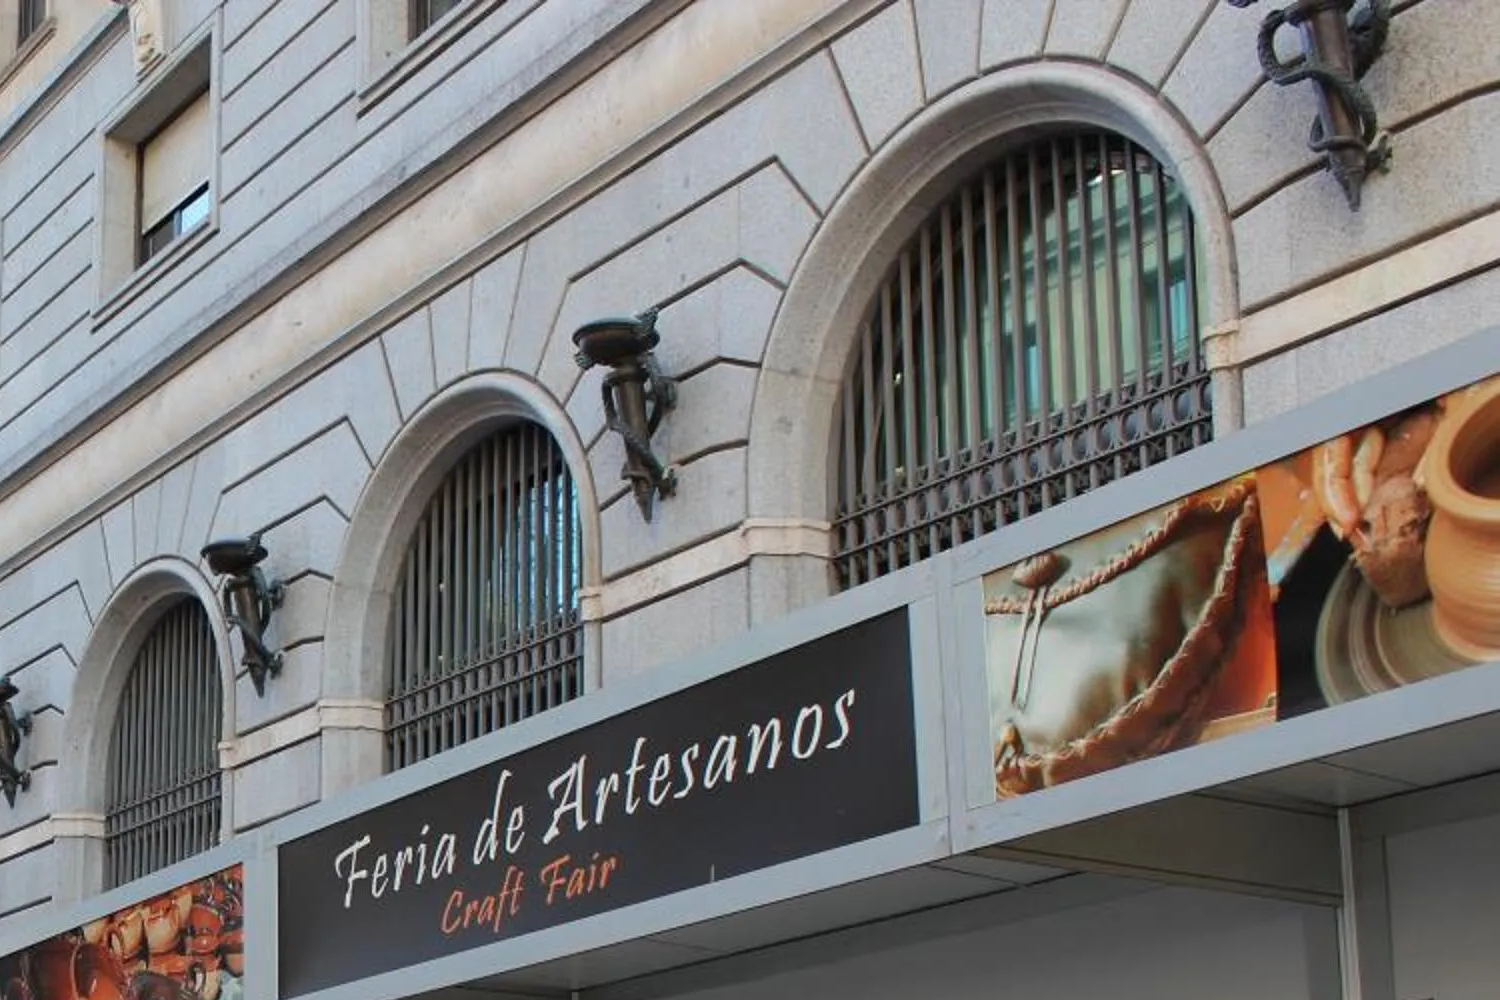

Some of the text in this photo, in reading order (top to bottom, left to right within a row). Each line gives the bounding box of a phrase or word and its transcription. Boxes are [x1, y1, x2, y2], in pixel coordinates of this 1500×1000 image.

[334, 688, 855, 909] Feria de Artesanos
[439, 853, 618, 935] Craft Fair
